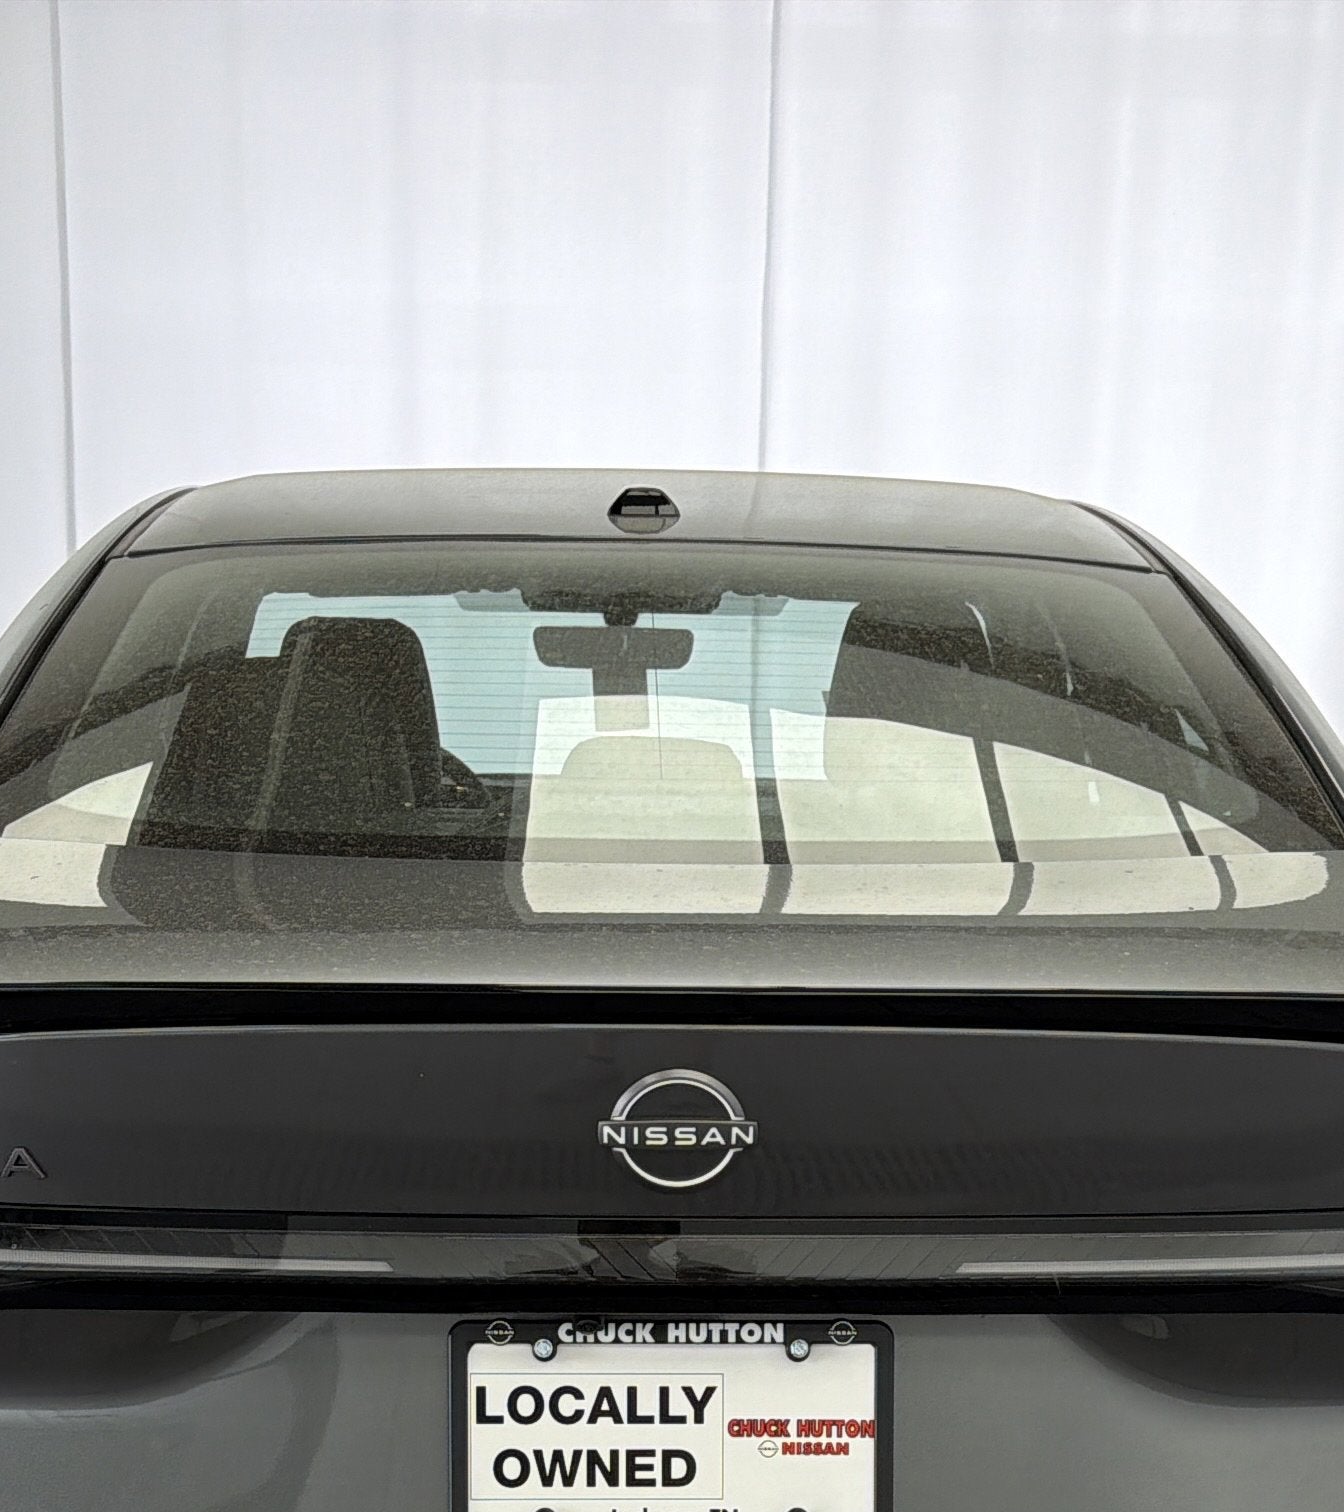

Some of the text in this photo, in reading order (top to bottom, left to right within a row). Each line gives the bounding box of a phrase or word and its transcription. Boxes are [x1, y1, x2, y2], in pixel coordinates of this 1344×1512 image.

[603, 1125, 754, 1146] NISSAN
[667, 1322, 785, 1343] HUTTON
[475, 1385, 718, 1425] LOCALLY
[727, 1418, 875, 1438] CHUCK HUTTON
[781, 1441, 850, 1456] NISSAN
[492, 1447, 697, 1488] OWNED
